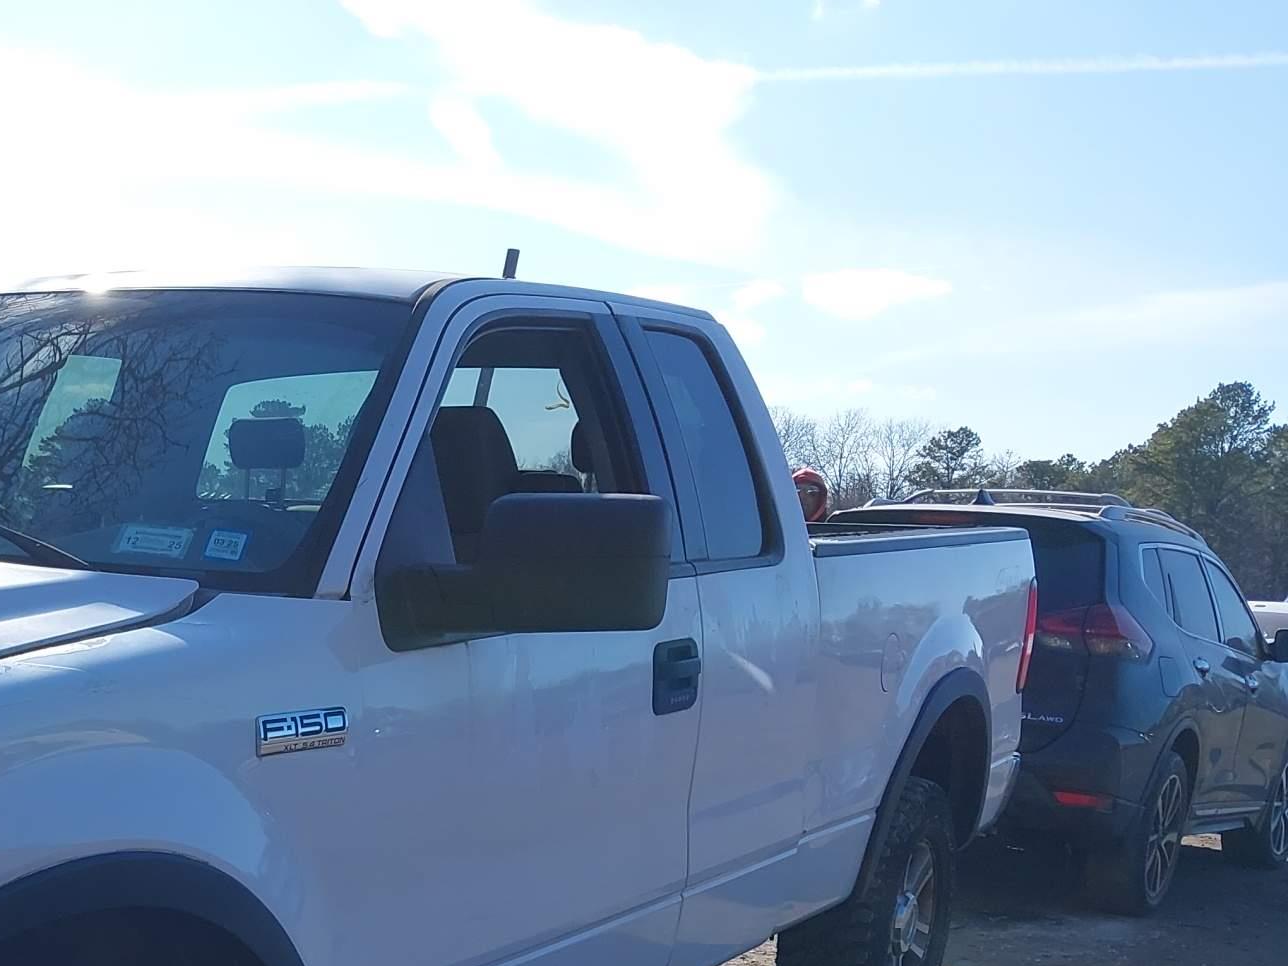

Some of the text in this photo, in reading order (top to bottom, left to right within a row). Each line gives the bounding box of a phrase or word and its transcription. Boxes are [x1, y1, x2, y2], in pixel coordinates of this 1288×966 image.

[1039, 714, 1064, 723] AWD
[262, 710, 346, 742] F-150
[283, 743, 298, 752] XLT
